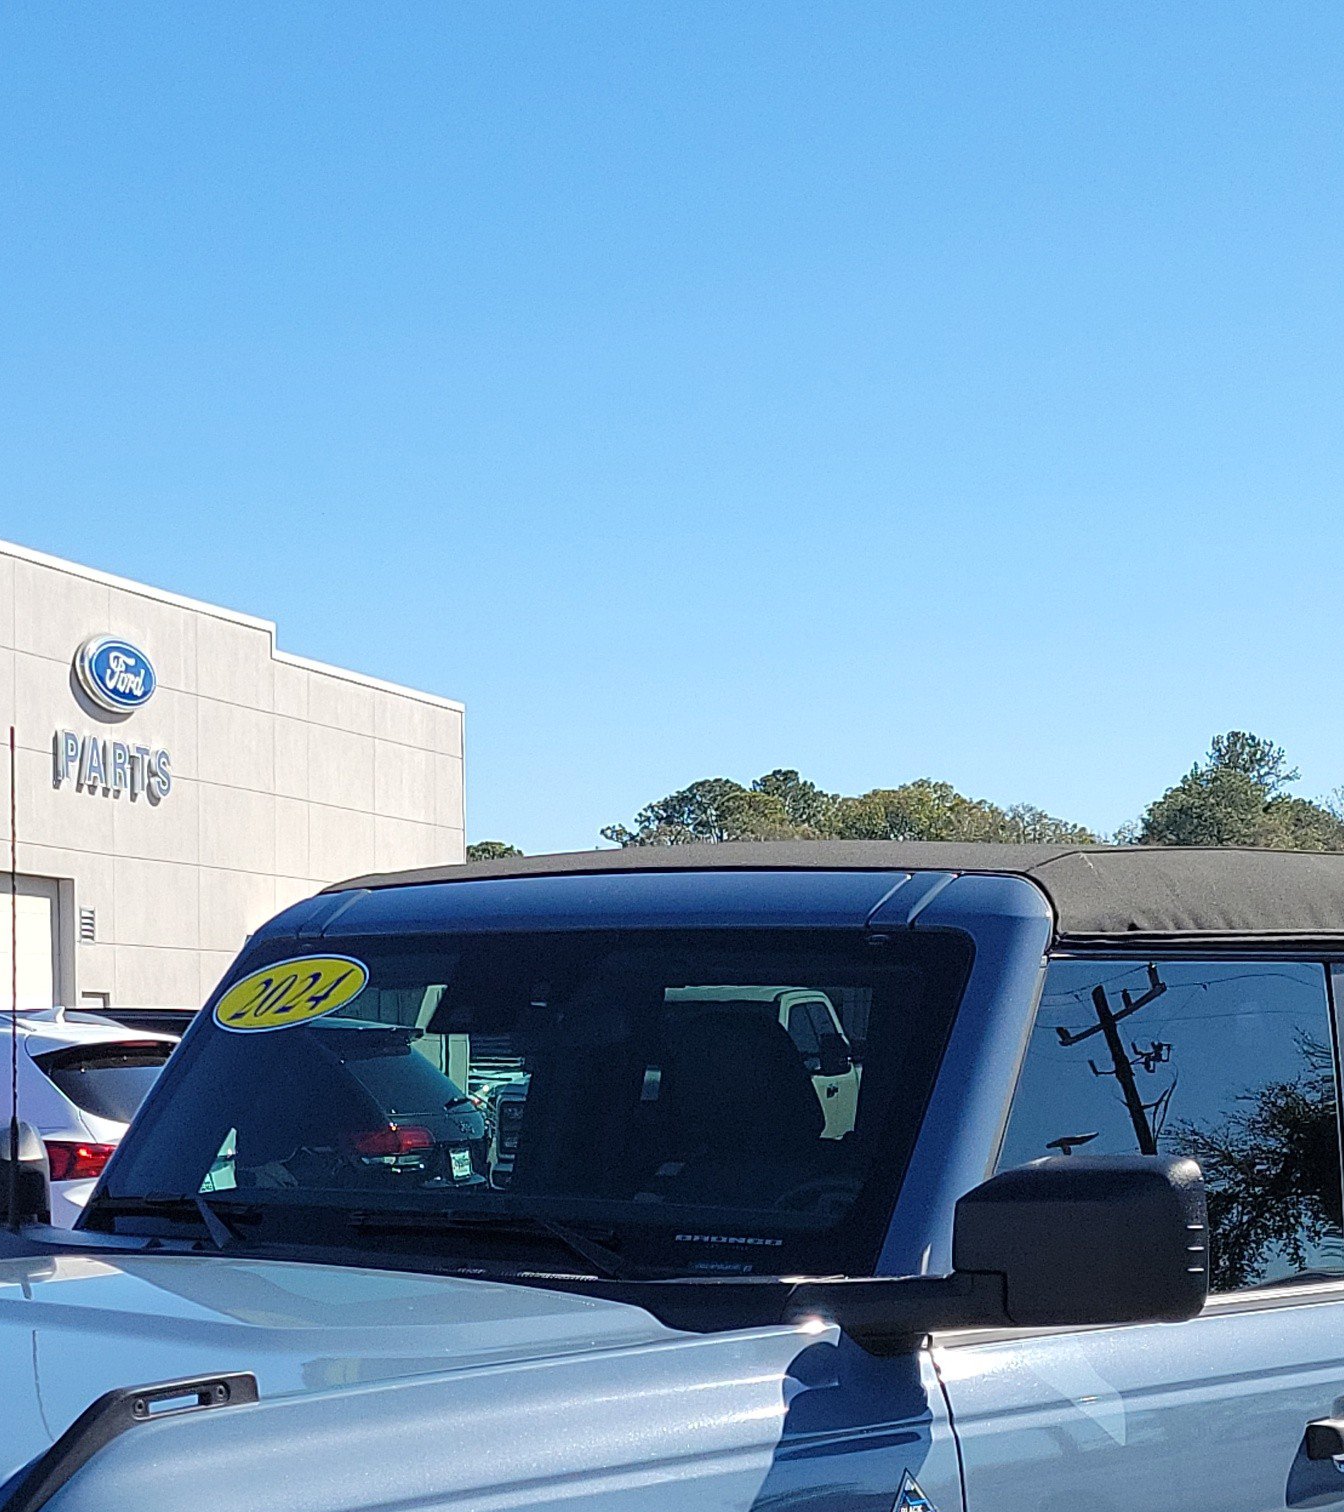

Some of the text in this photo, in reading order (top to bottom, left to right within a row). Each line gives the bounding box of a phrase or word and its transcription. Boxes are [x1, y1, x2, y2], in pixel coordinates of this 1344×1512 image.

[106, 651, 145, 696] Ford
[59, 730, 171, 798] PARTS
[227, 967, 356, 1022] 2024
